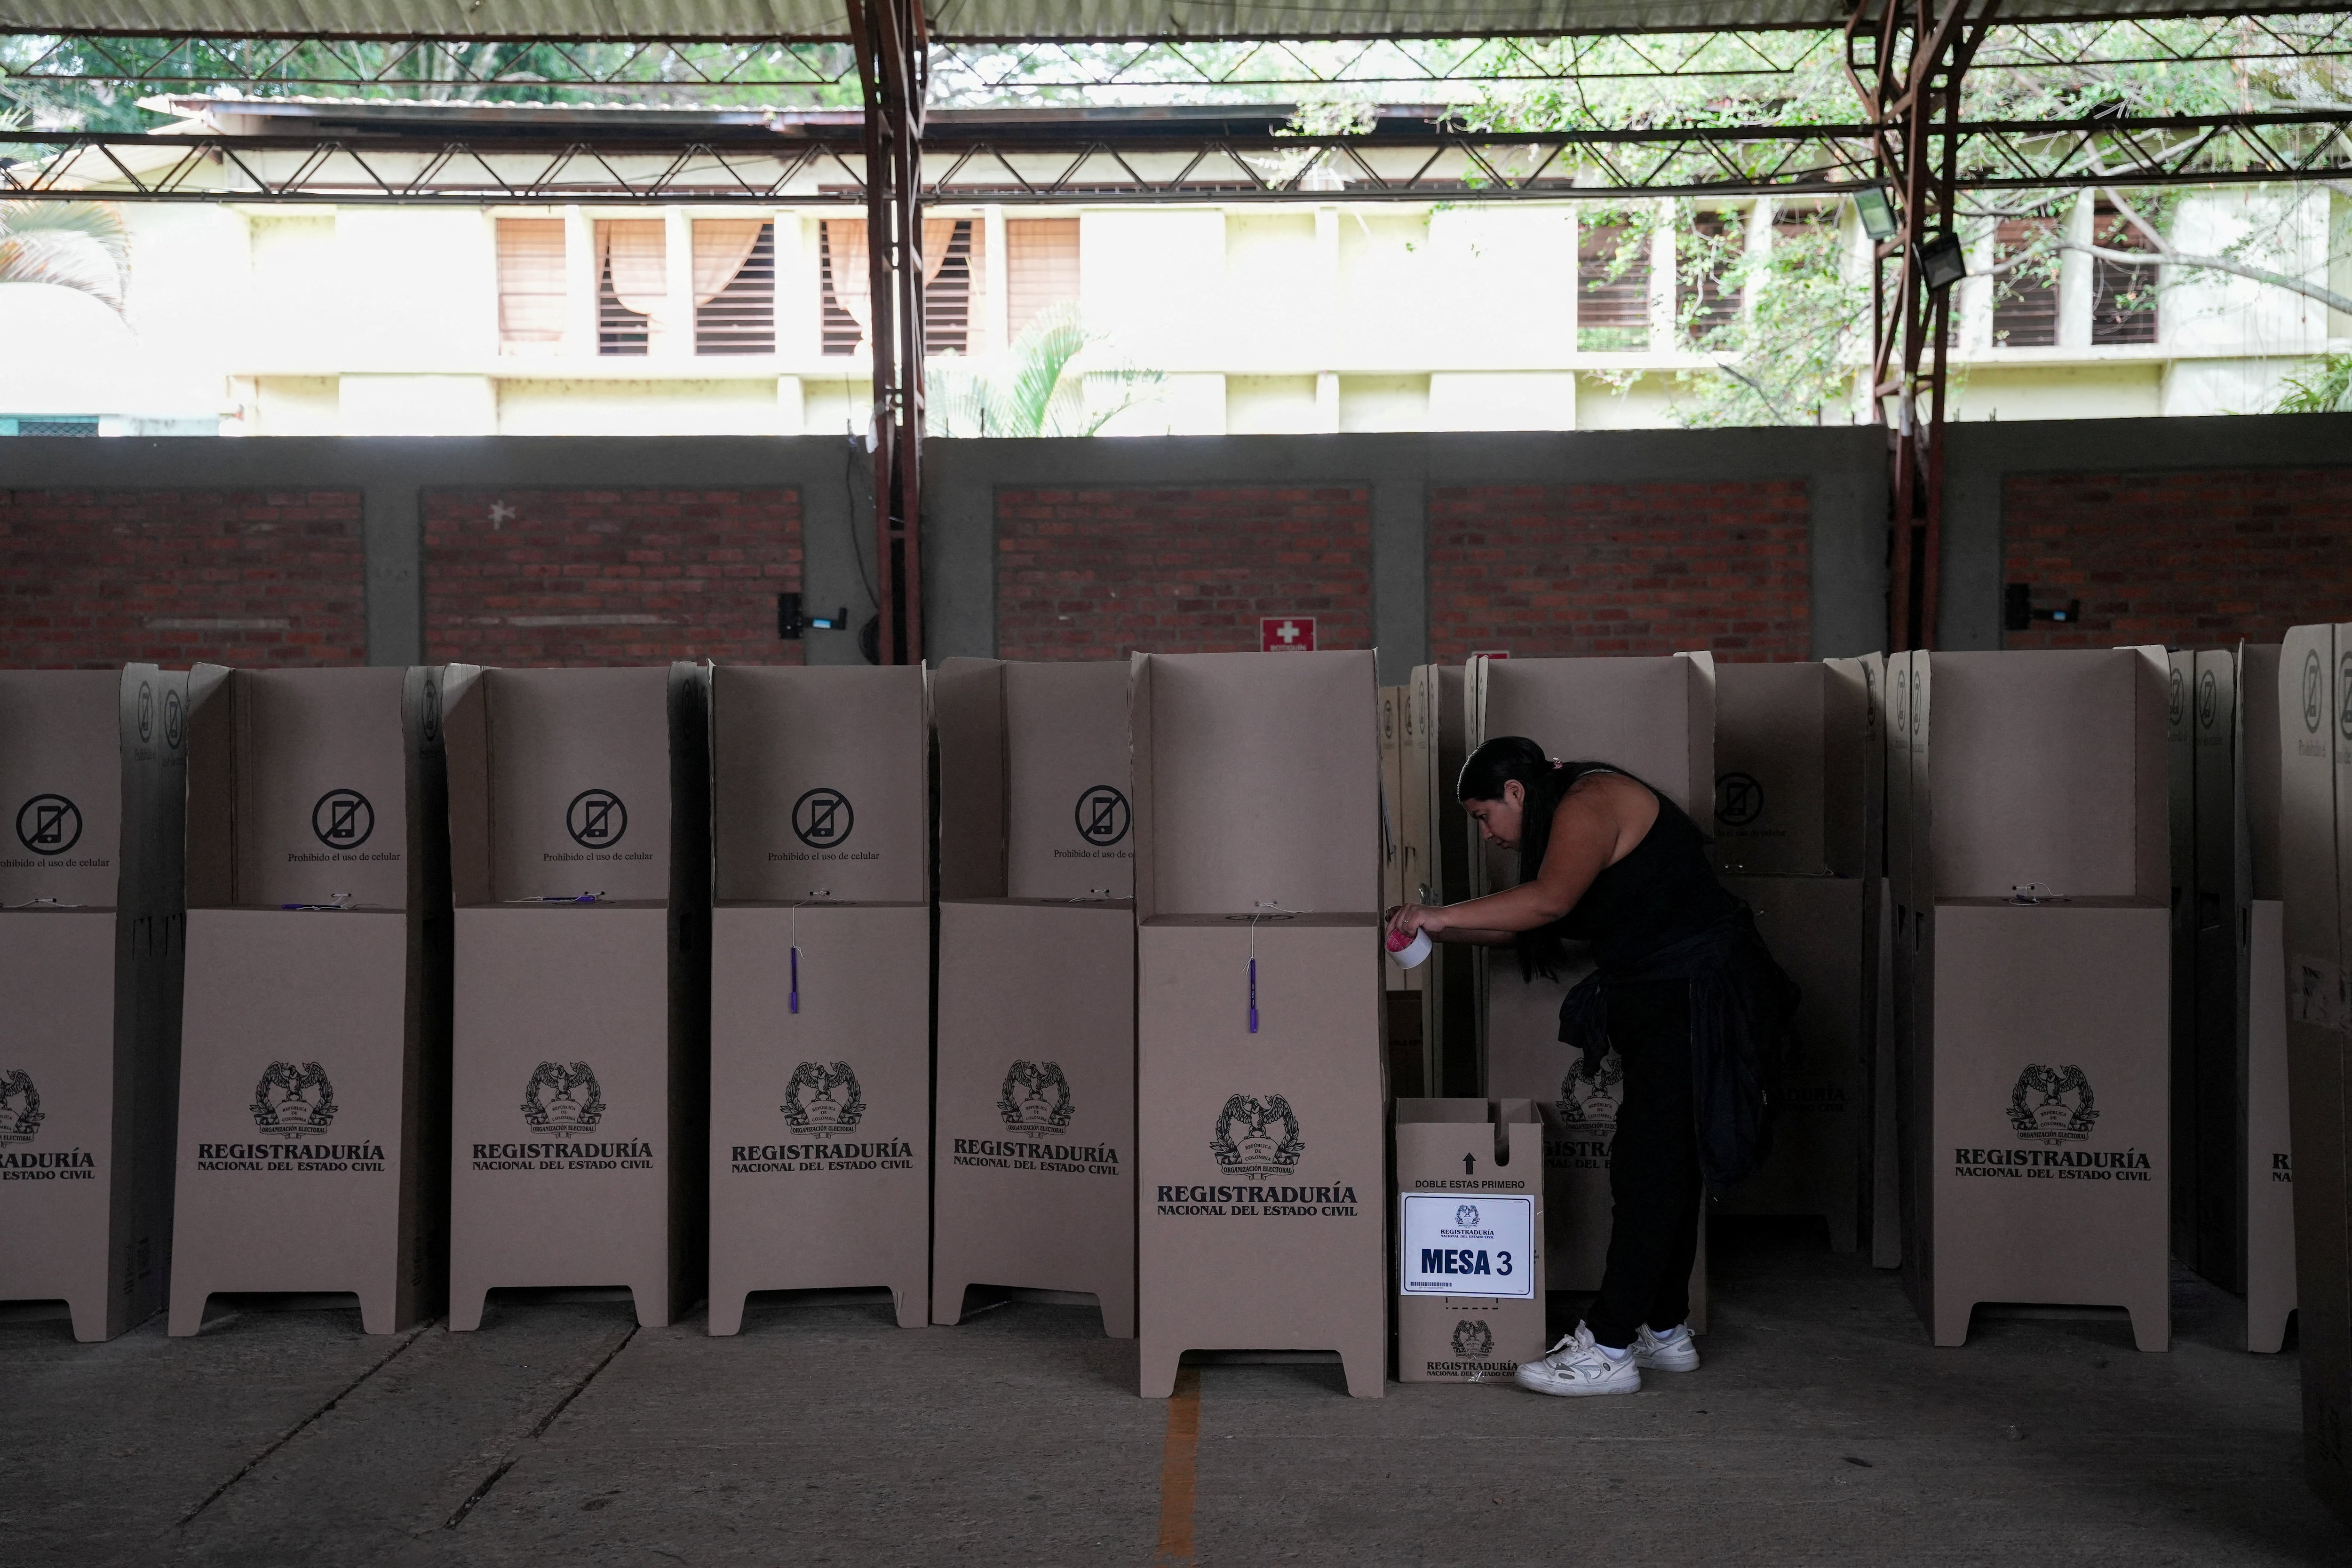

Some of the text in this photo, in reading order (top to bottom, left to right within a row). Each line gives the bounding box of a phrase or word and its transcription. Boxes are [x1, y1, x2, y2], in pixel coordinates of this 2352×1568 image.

[372, 852, 401, 861] celular
[768, 852, 810, 861] Prohibido
[1054, 849, 1090, 858] Prohibido
[793, 1125, 827, 1133] ORGANIZACIÓN
[198, 1140, 385, 1159] REGISTRADURÍA
[473, 1138, 653, 1158] REGISTRADURÍA
[732, 1137, 913, 1161] REGISTRADURÍA
[954, 1138, 1119, 1164] REGISTRADURÍA
[1576, 1159, 1599, 1168] DEL
[1955, 1148, 2150, 1169] REGISTRADURÍA
[198, 1162, 385, 1171] NACIONAL DEL ESTADO CIVIL
[540, 1161, 564, 1170] DEL
[569, 1161, 617, 1169] ESTADO
[732, 1160, 913, 1173] NACIONAL DEL ESTADO CIVIL
[954, 1156, 1119, 1175] NACIONAL DEL ESTADO CIVIL
[1224, 1164, 1261, 1173] ORGANIZACIÓN
[3, 1171, 95, 1180] ESTADO CIVIL
[1955, 1167, 2151, 1181] NACIONAL DEL ESTADO CIVIL
[1158, 1181, 1358, 1203] REGISTRADURÍA
[1158, 1206, 1358, 1216] NACIONAL DEL ESTADO CIVIL
[1422, 1249, 1491, 1275] MESA
[1496, 1251, 1512, 1275] 3
[1427, 1360, 1518, 1370] REGISTRADURÍA
